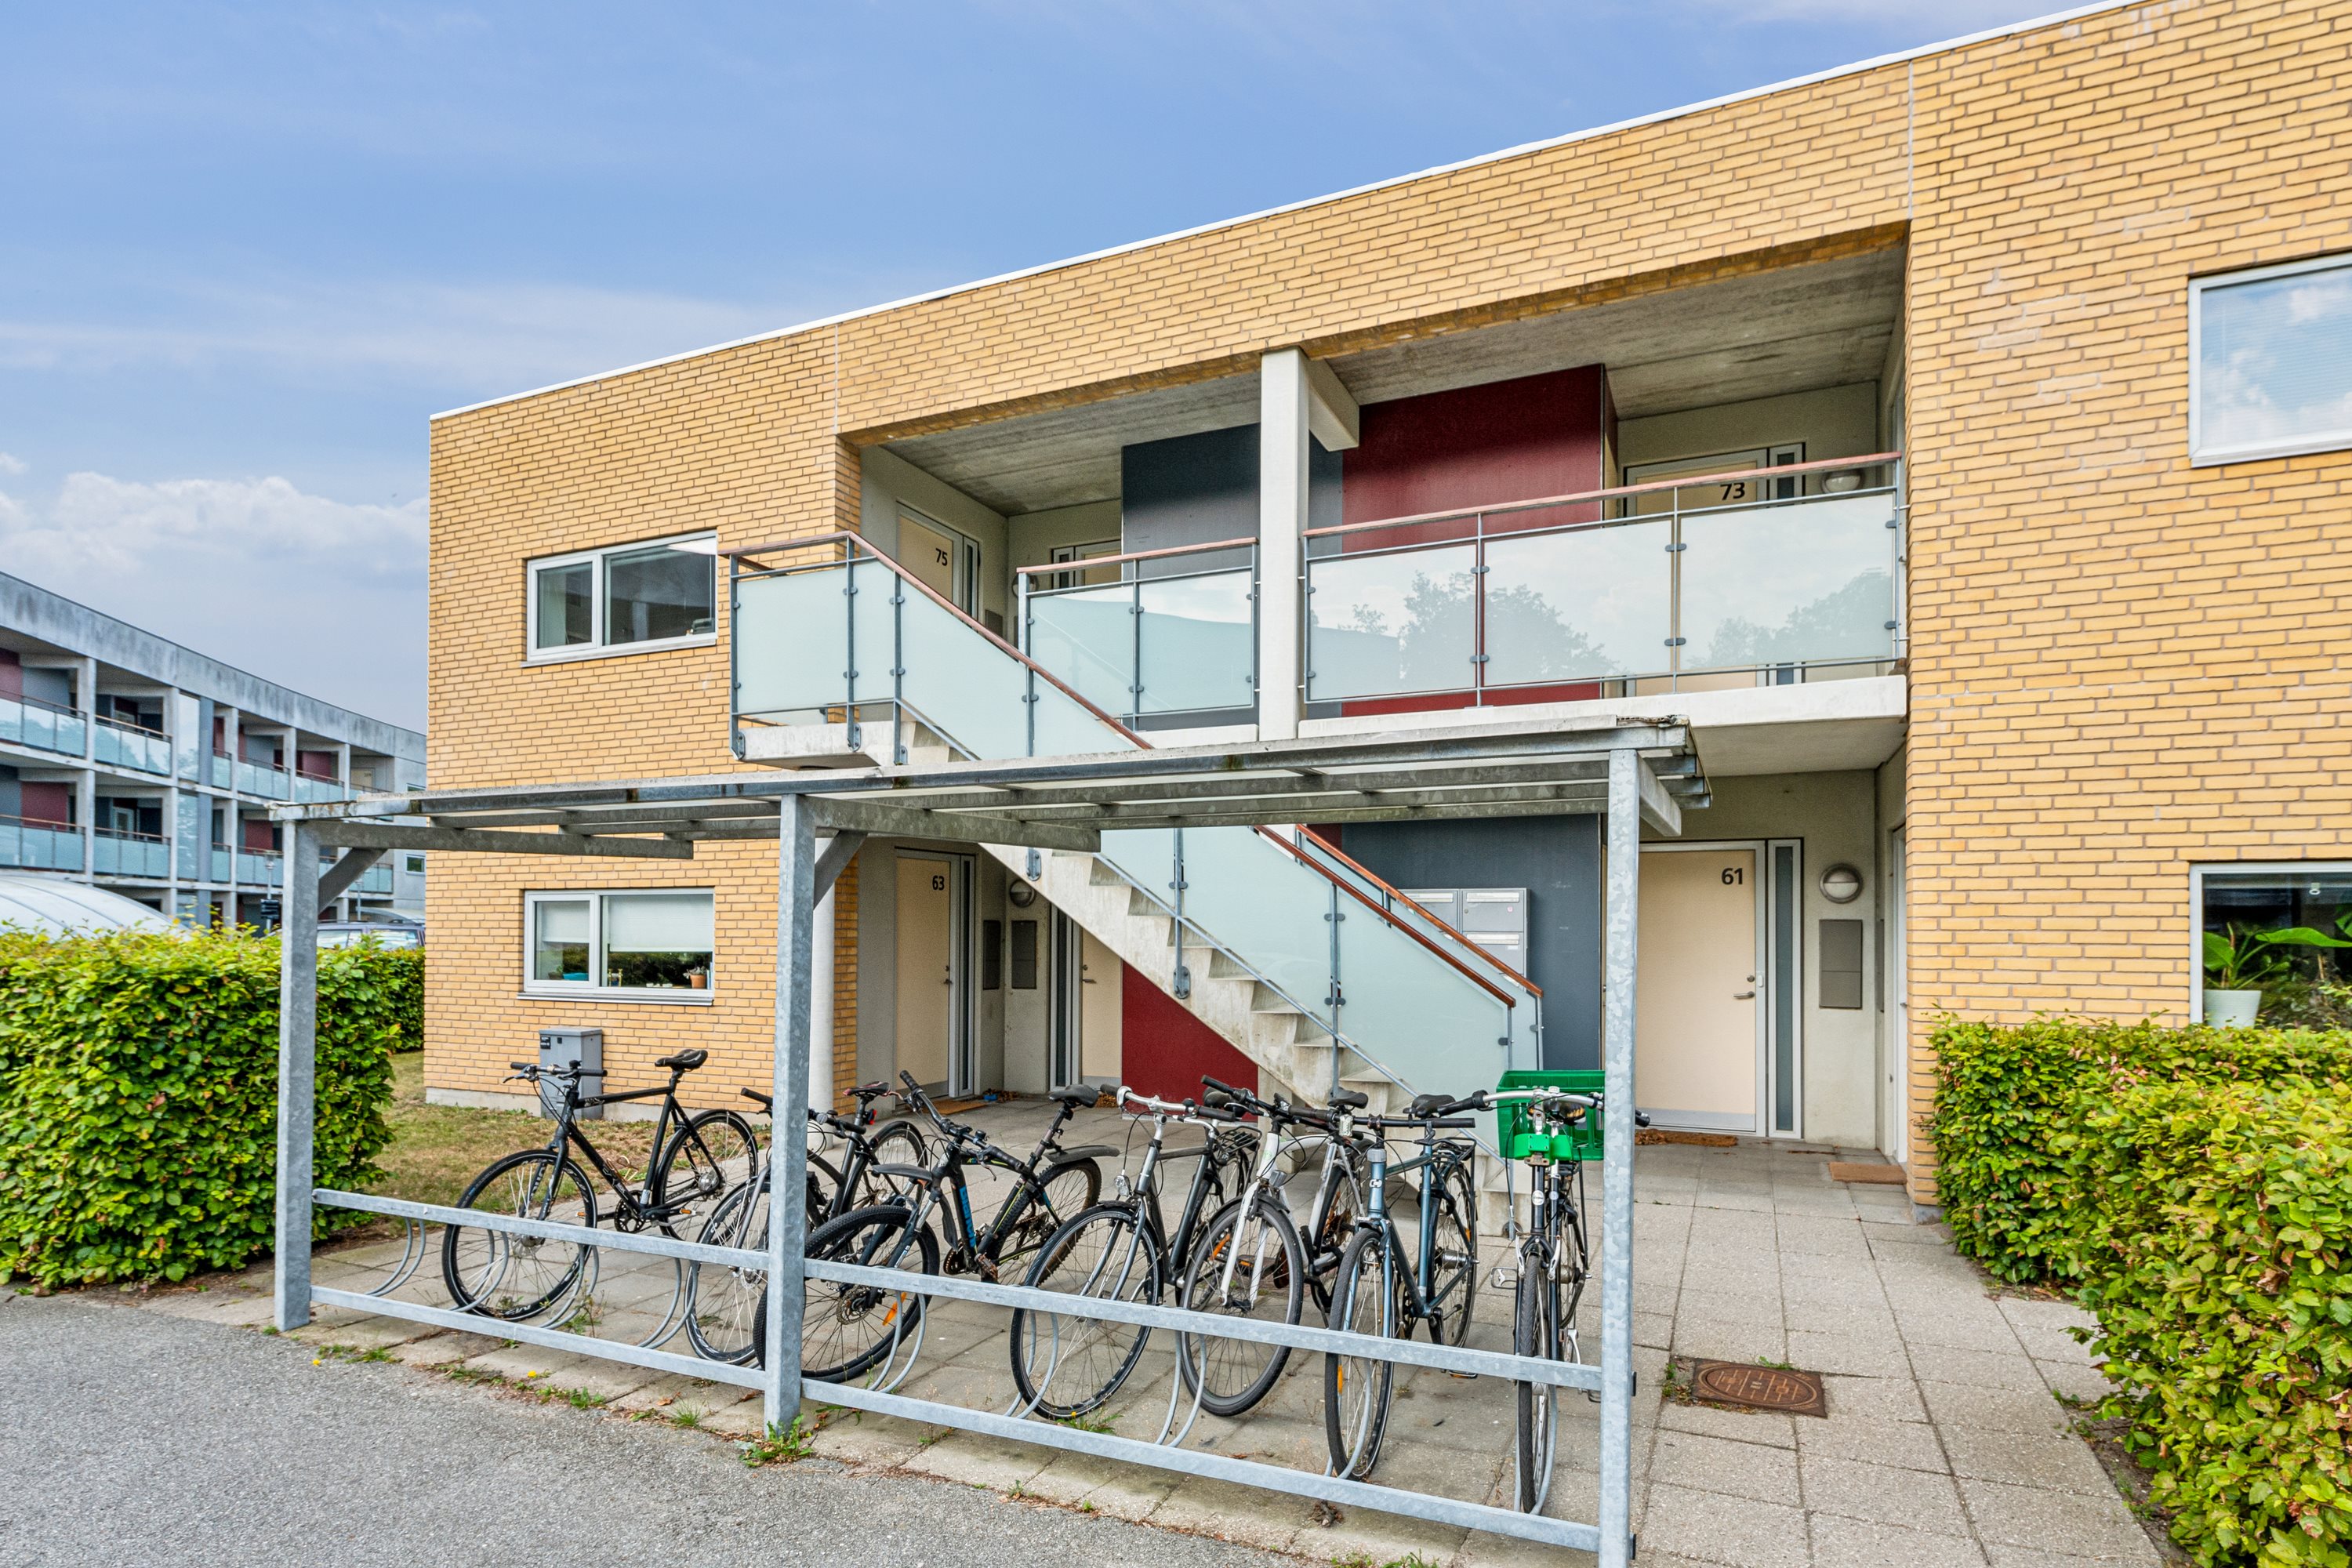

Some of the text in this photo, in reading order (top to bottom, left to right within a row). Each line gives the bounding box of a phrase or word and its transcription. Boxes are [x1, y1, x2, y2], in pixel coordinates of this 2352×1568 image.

[1720, 482, 1745, 501] 73
[935, 548, 948, 566] 75
[932, 875, 945, 891] 63
[1722, 867, 1743, 885] 61
